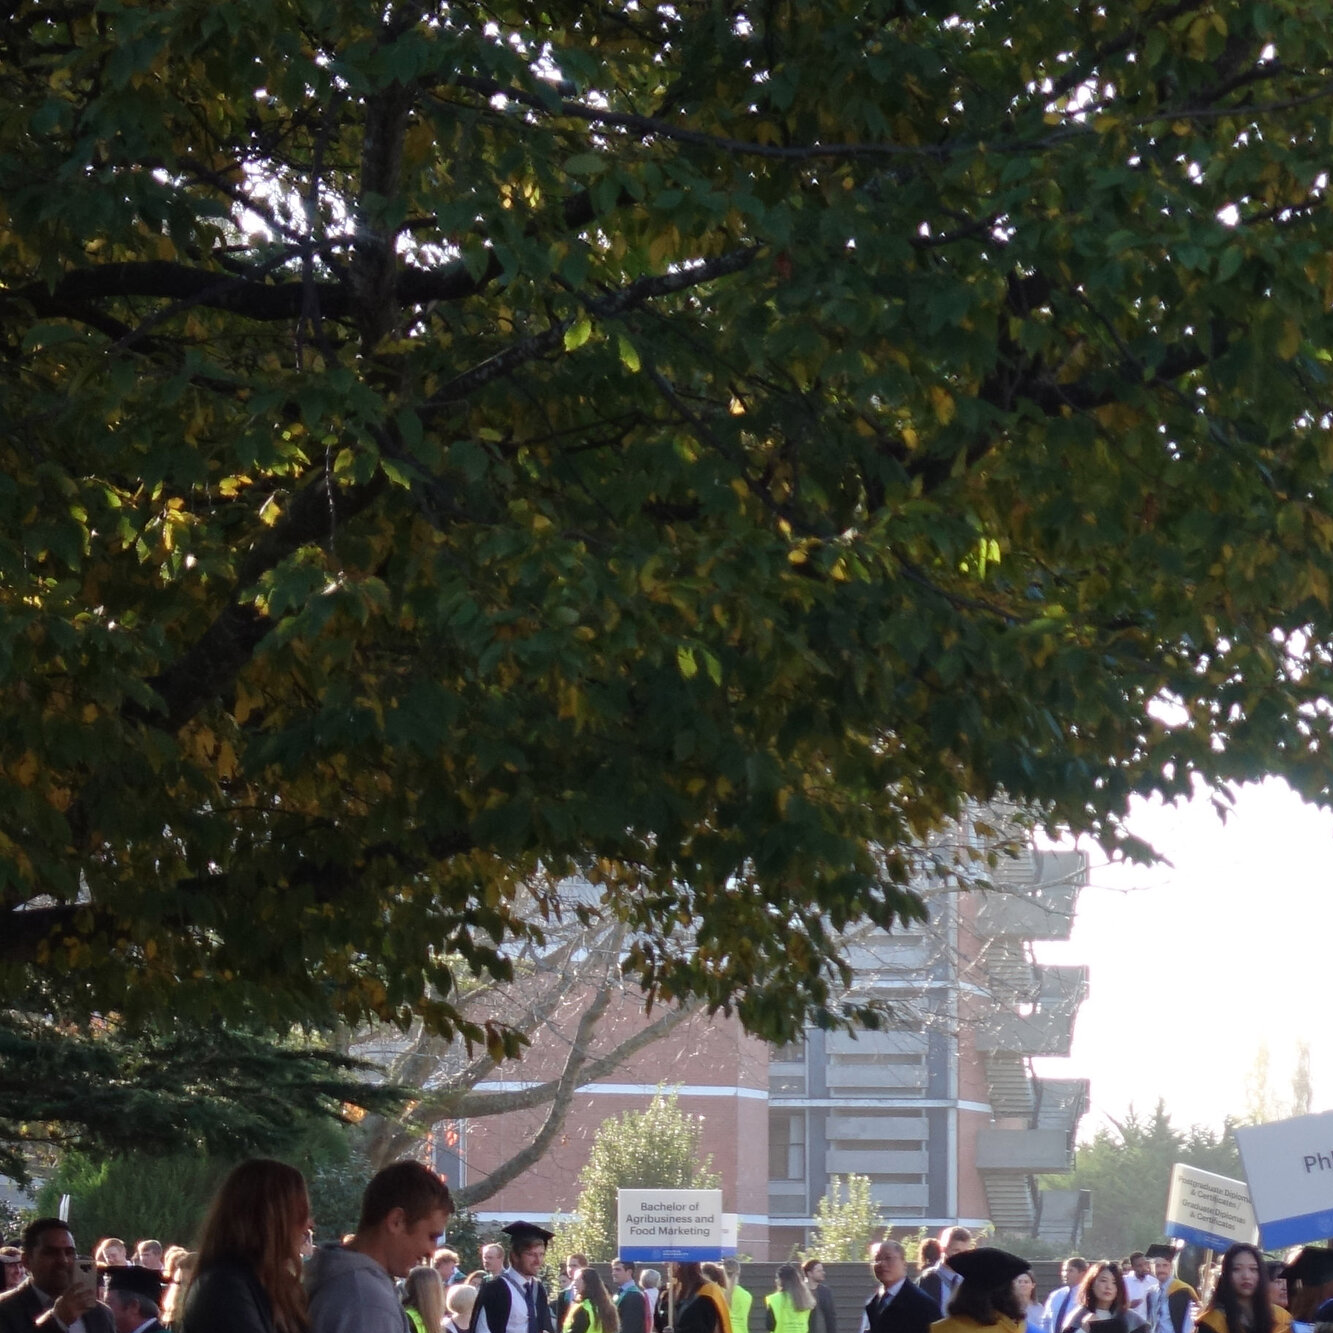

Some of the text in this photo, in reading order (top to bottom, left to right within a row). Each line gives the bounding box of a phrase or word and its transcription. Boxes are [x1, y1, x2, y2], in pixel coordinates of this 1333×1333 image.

[1178, 1175, 1224, 1195] Postgraduate
[640, 1202, 700, 1212] Bachelor of
[1198, 1191, 1236, 1208] Certificates
[626, 1214, 714, 1225] Agribusiness and
[1182, 1199, 1246, 1224] Graduate Diplomas
[1197, 1213, 1236, 1230] Certificates
[630, 1226, 655, 1236] Food
[658, 1227, 710, 1237] Marketing
